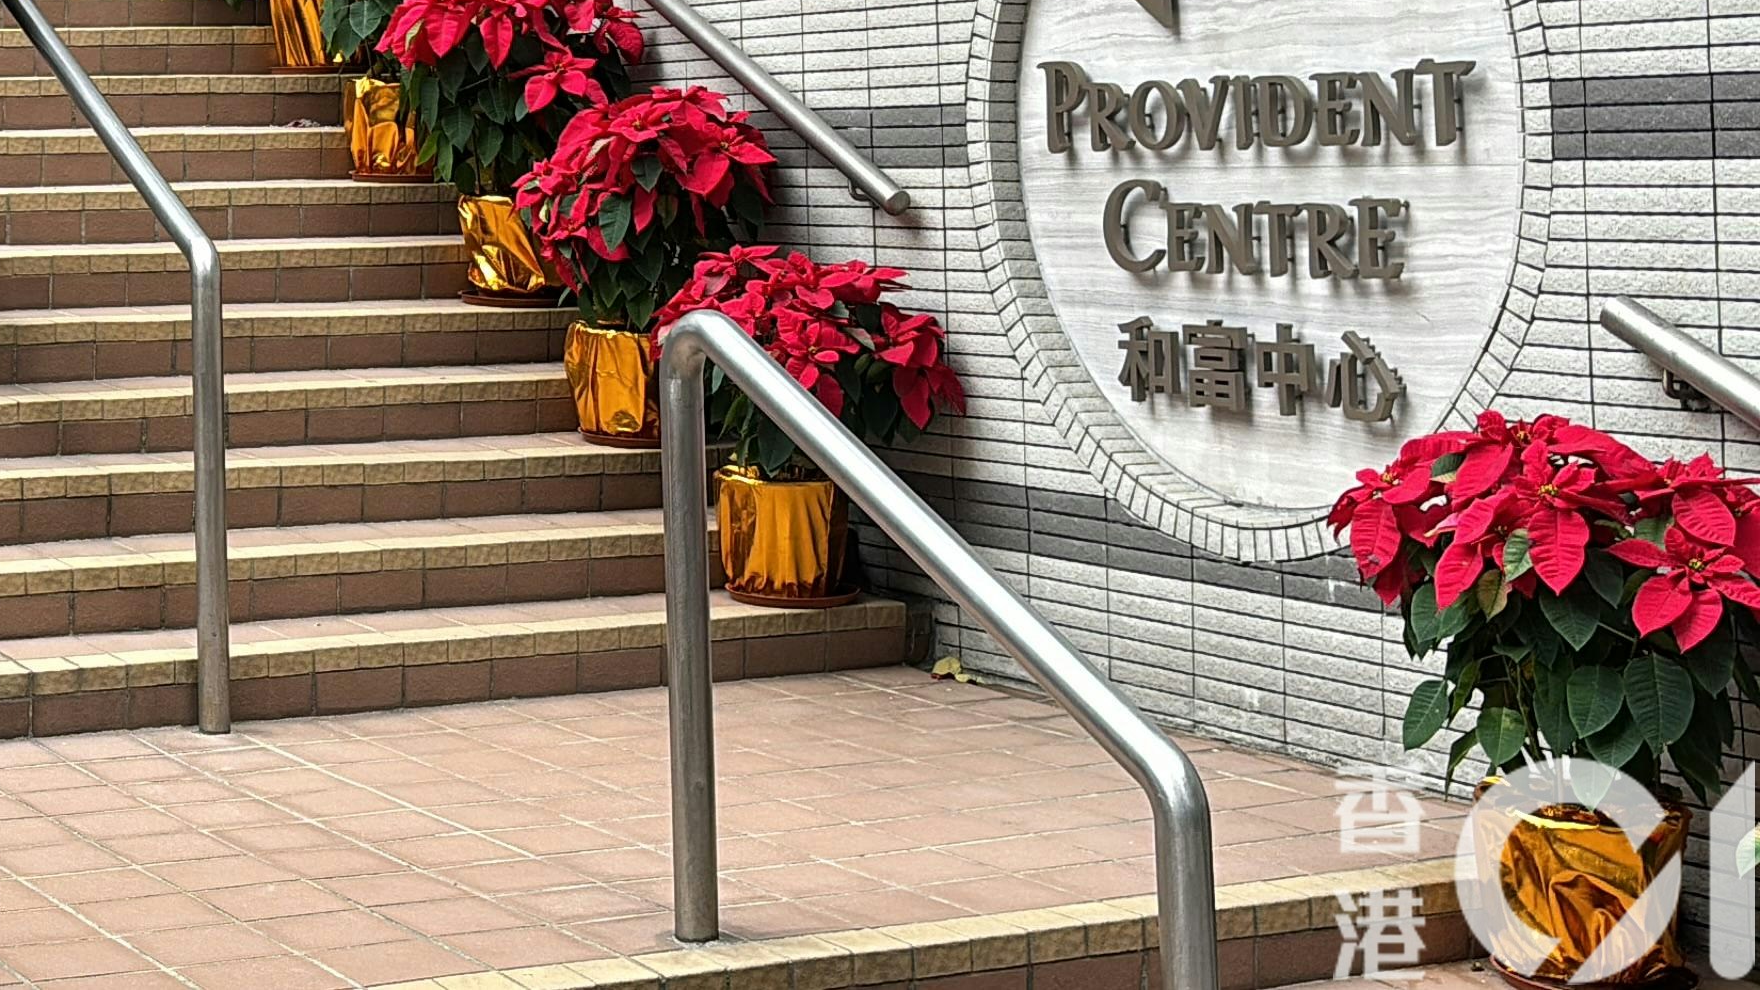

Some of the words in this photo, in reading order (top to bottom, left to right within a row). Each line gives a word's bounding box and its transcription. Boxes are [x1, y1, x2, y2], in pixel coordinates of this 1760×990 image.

[1037, 58, 1477, 154] PROVIDENT
[1103, 178, 1410, 280] CENTRE
[1117, 315, 1406, 422] 和富中心
